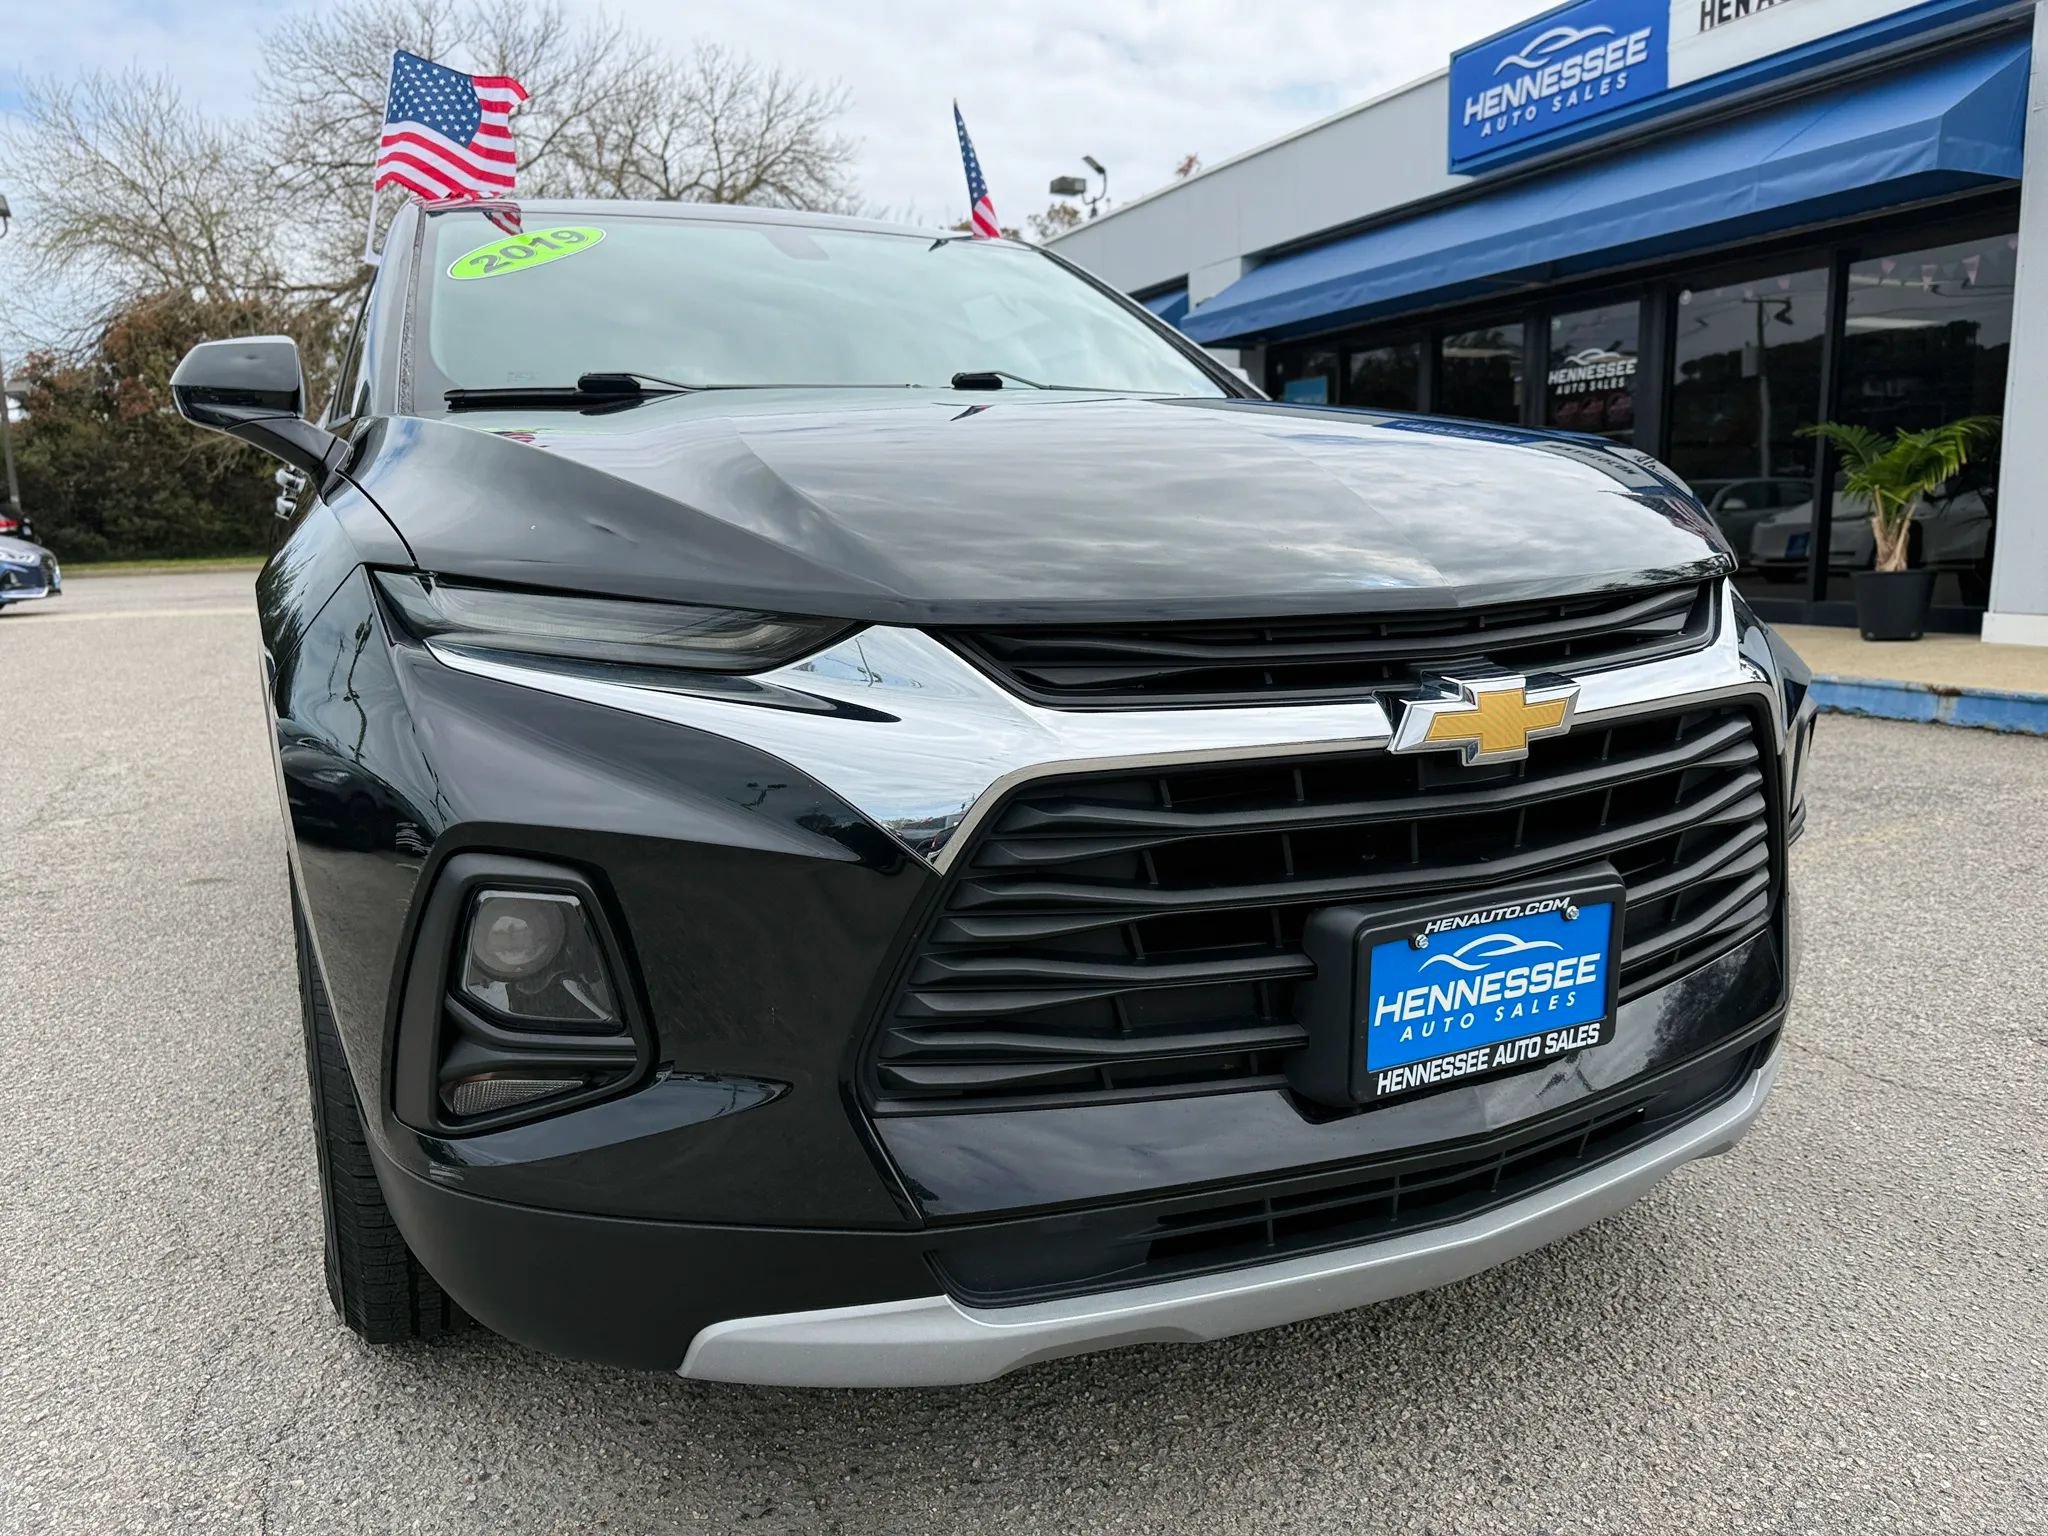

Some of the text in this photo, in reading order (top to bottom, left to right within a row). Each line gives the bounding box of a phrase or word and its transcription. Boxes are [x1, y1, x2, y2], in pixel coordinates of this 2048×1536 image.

[1700, 0, 1792, 32] HEN
[1464, 26, 1652, 127] HENNESSEE
[1480, 72, 1628, 138] AUTO SALES
[469, 230, 589, 274] 2019
[1547, 358, 1638, 385] HENNESSEE
[1556, 377, 1625, 395] AUTO SALES
[1424, 896, 1571, 935] HENAUTO.COM
[1373, 953, 1601, 1027] HENNESSEE
[1400, 991, 1576, 1042] AUTO SALES
[1376, 1022, 1601, 1096] HENNESSEE AUTO SALES
